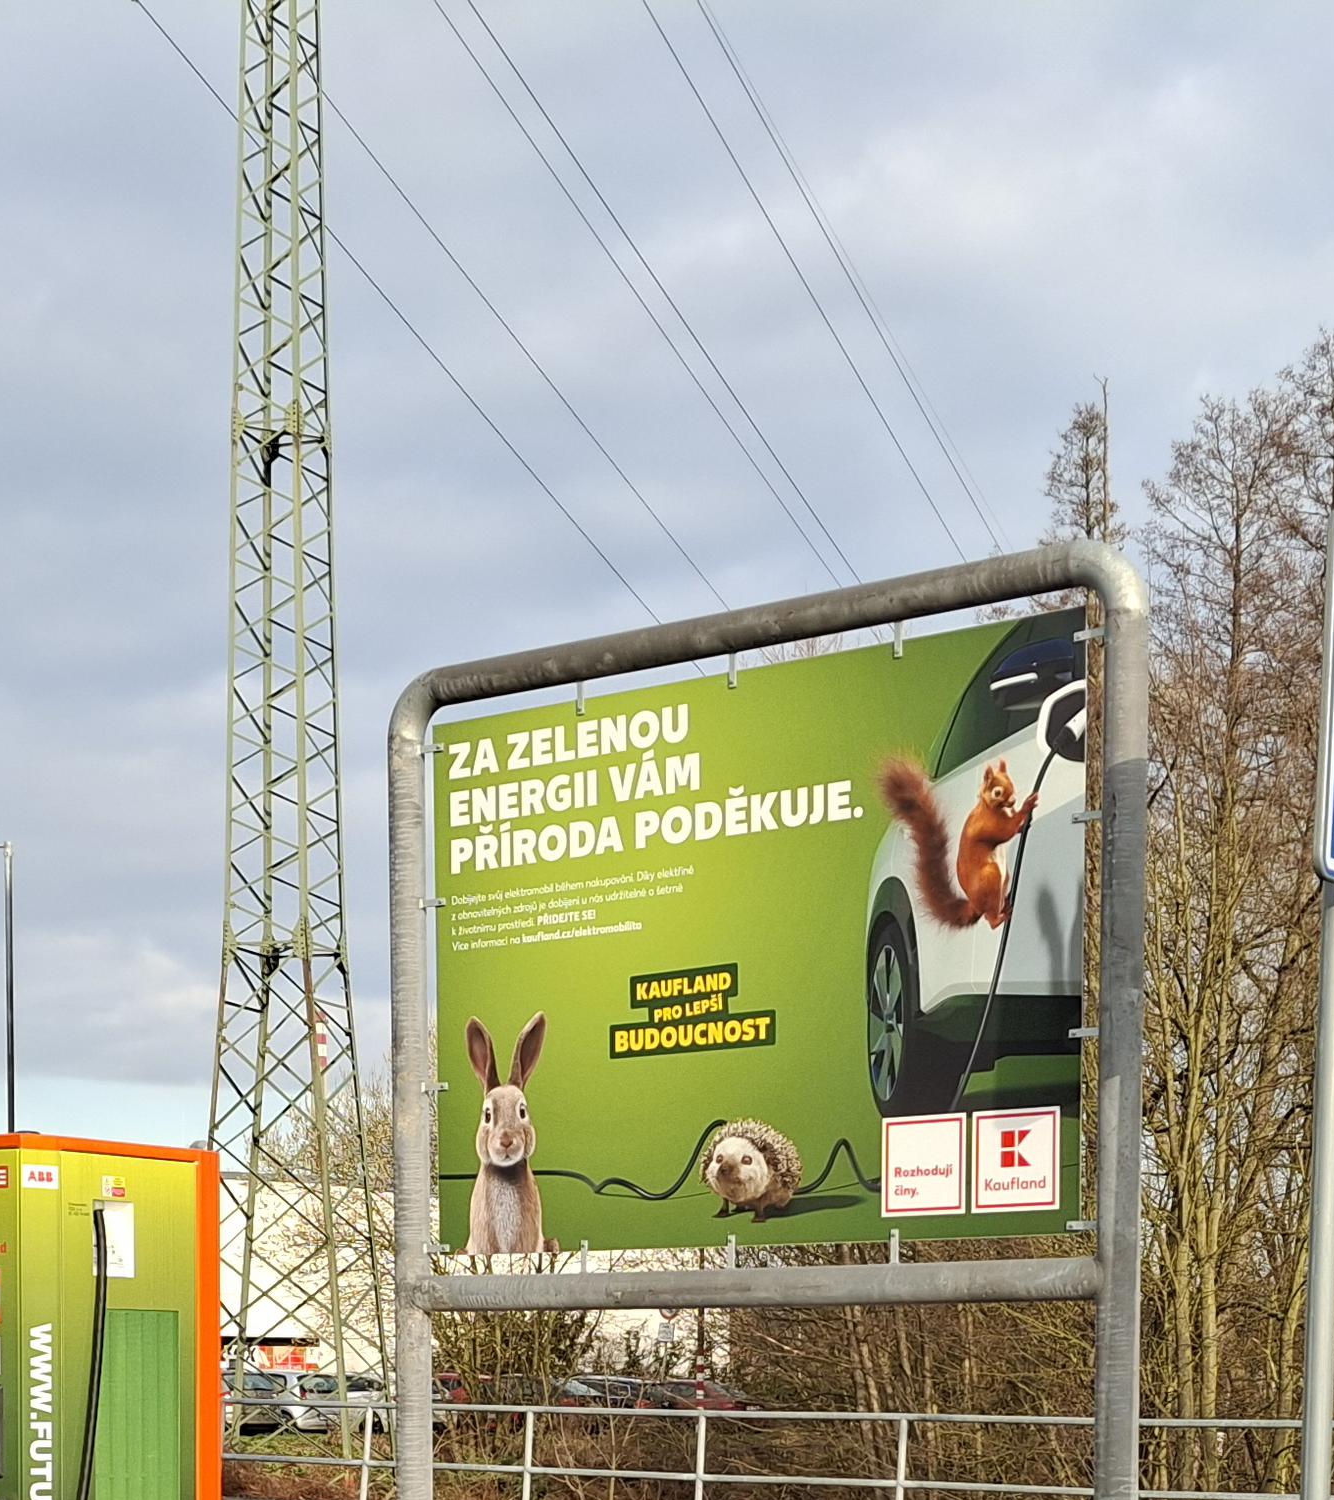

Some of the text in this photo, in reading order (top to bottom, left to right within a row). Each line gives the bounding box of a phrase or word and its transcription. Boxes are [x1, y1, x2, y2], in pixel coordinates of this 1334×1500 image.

[448, 704, 689, 780] ZA ZELENOU
[449, 749, 701, 828] ENERGII VÁM
[450, 780, 864, 875] PŘÍRODA PODĚKUJE.
[504, 884, 555, 899] elektromobil
[555, 880, 585, 893] během
[538, 902, 547, 912] je
[451, 927, 457, 936] k
[636, 972, 732, 1001] KAUFLAND
[653, 992, 724, 1023] PRO LEPŠÍ
[614, 1016, 771, 1053] BUDOUCNOST
[27, 1170, 54, 1183] ABB
[894, 1163, 954, 1178] Rozhodují
[894, 1184, 919, 1199] činy.
[984, 1176, 1046, 1191] Kaufland
